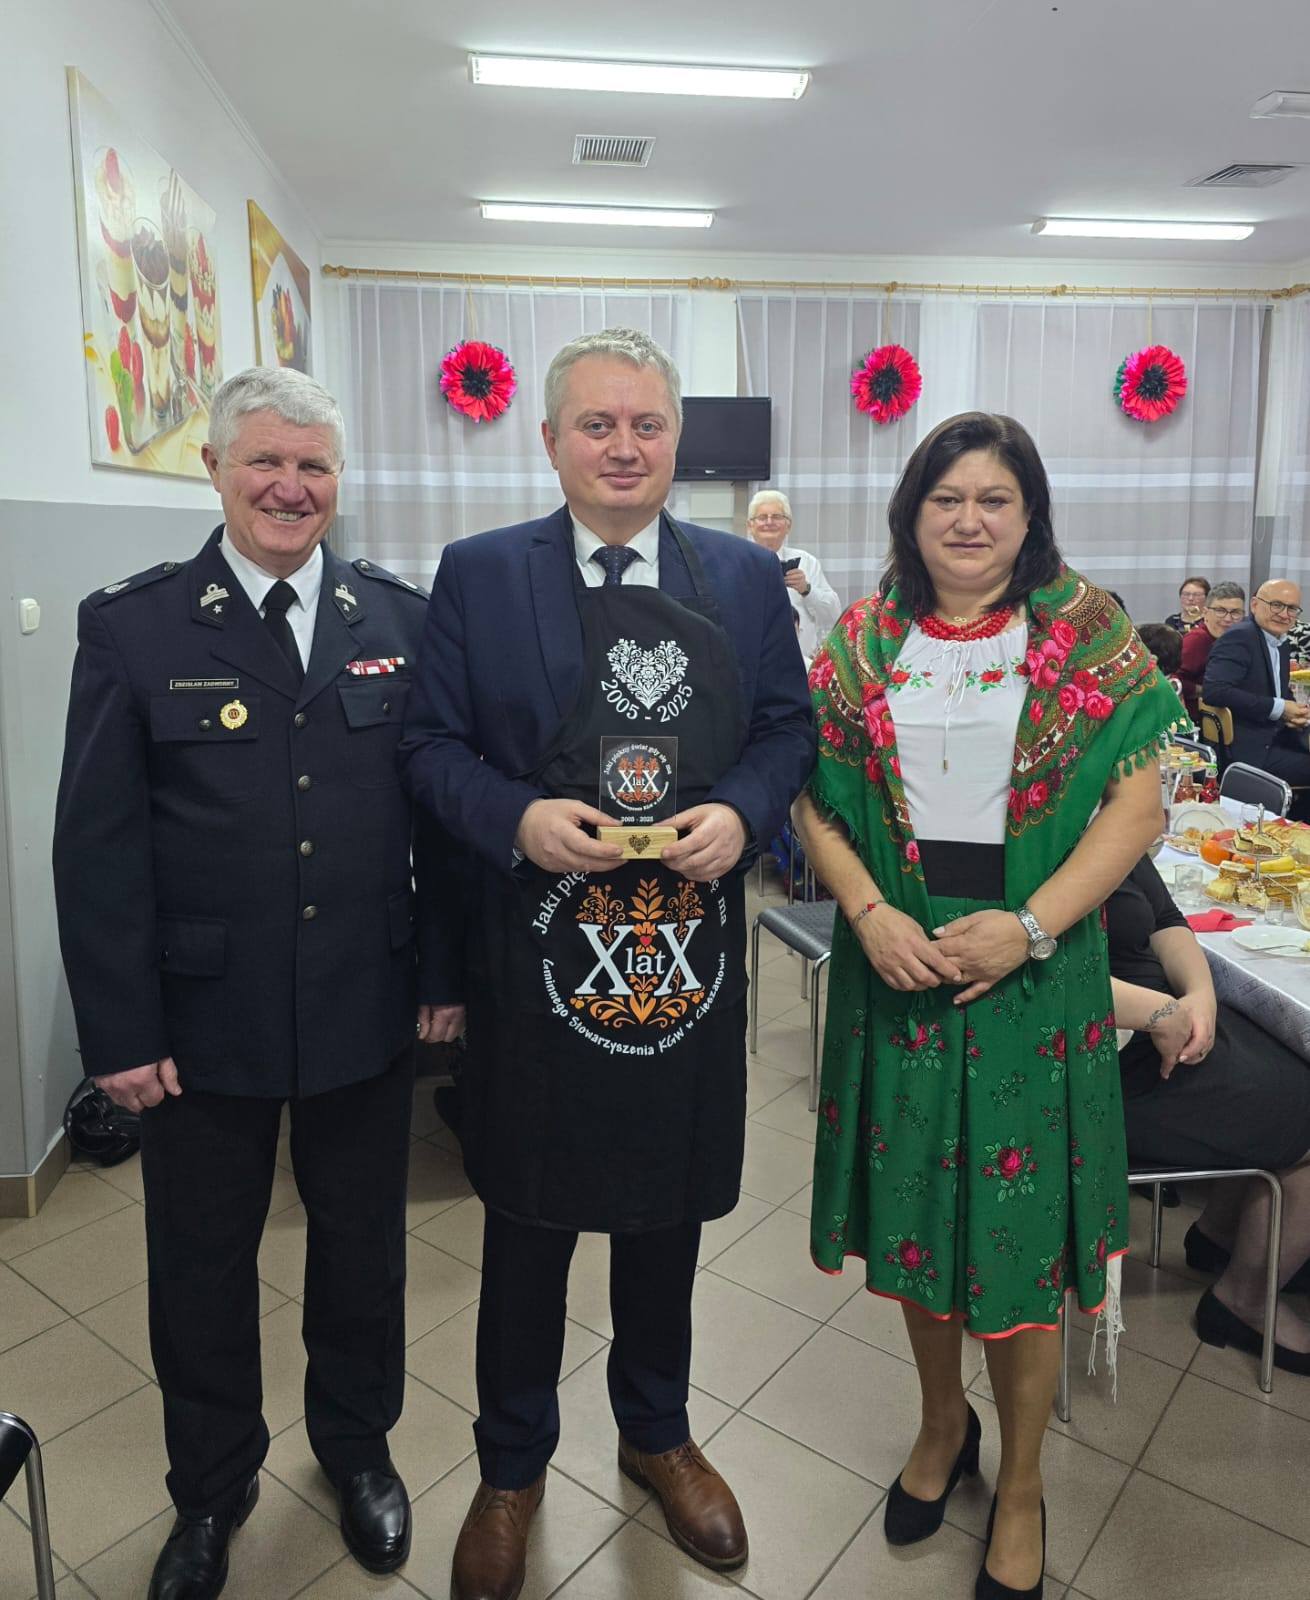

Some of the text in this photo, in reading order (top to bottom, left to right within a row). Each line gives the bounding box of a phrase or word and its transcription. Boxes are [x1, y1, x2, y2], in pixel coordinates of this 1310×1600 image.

[600, 678, 640, 720] 2005
[656, 684, 693, 723] 2025
[531, 871, 727, 935] Jaki pię ma
[624, 946, 666, 976] lat
[542, 958, 569, 1017] Gminnego
[568, 1016, 655, 1056] Stowarzyszenia
[658, 1026, 685, 1053] KGW
[685, 1020, 694, 1029] w
